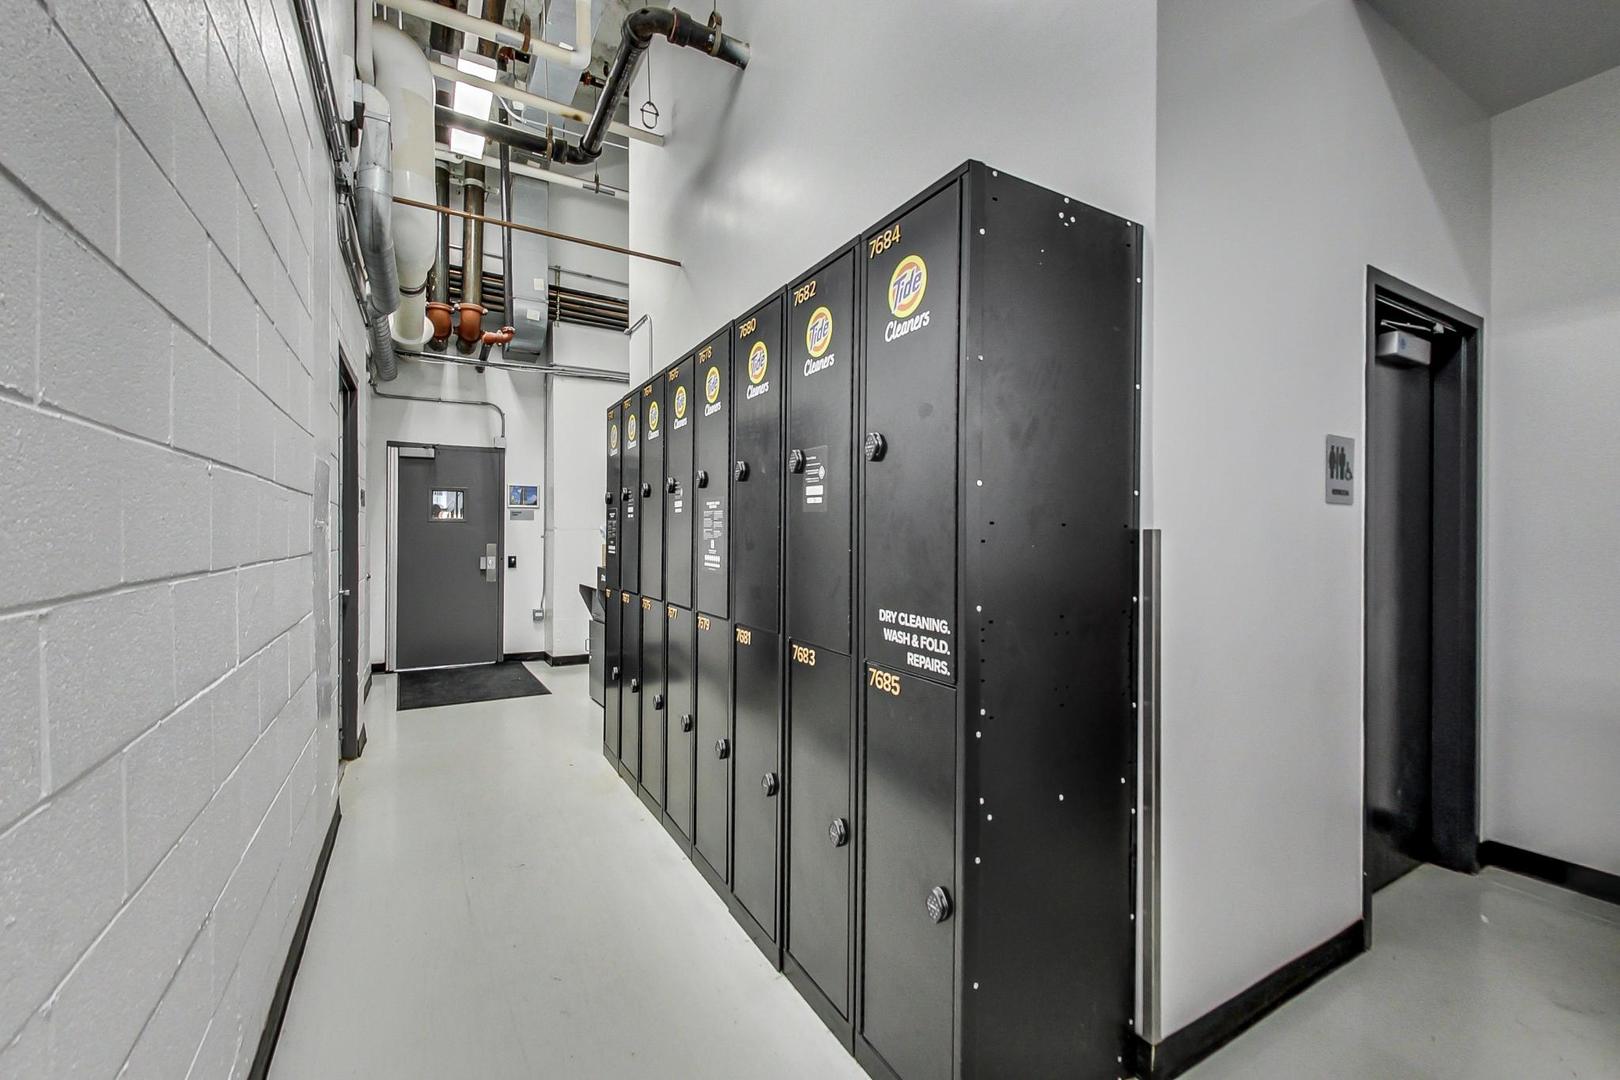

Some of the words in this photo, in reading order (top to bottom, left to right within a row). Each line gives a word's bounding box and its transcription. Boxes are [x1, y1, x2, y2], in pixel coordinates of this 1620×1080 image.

[869, 224, 901, 259] 7684
[793, 280, 816, 307] 7682
[892, 265, 922, 315] Tide
[738, 317, 757, 339] 7680
[810, 316, 830, 351] Tide
[884, 311, 931, 343] Cleaners
[751, 349, 766, 378] Tide
[803, 354, 835, 377] Cleaners
[746, 381, 770, 400] Cleaners
[878, 608, 897, 624] DRY
[897, 612, 951, 635] CLEANING.
[735, 627, 751, 645] 7681
[883, 628, 911, 646] WASH
[911, 634, 920, 648] &
[920, 635, 951, 656] FOLD.
[792, 644, 816, 666] 7683
[906, 652, 951, 676] REPAIRS.
[868, 668, 901, 696] 7685
